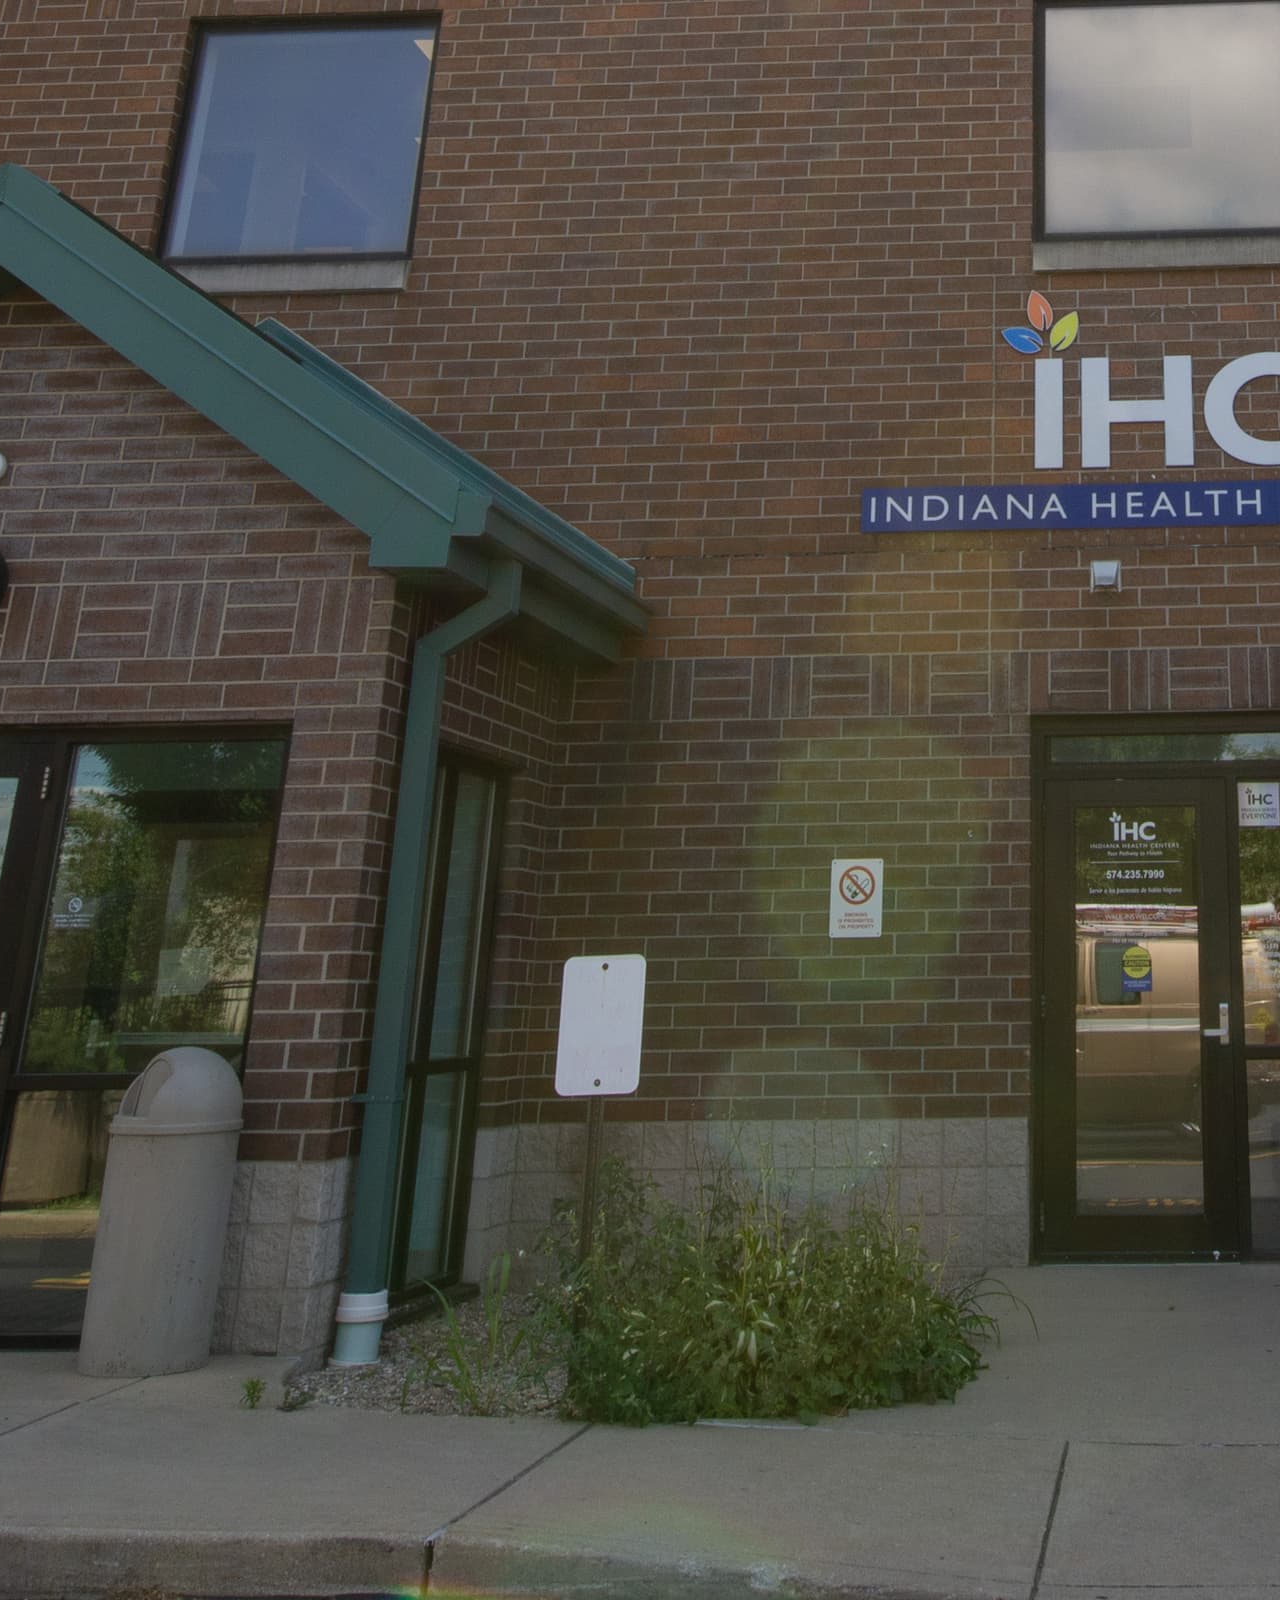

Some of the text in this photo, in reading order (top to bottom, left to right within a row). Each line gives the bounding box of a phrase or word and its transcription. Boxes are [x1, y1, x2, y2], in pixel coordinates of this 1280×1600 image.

[869, 493, 1068, 524] INDIANA
[1091, 488, 1262, 519] HEALTH
[1248, 793, 1273, 806] IHC
[1113, 821, 1157, 842] IHC
[1090, 841, 1180, 850] INDIANA HEALTH CENTERS
[1106, 869, 1165, 880] 574.235.7990
